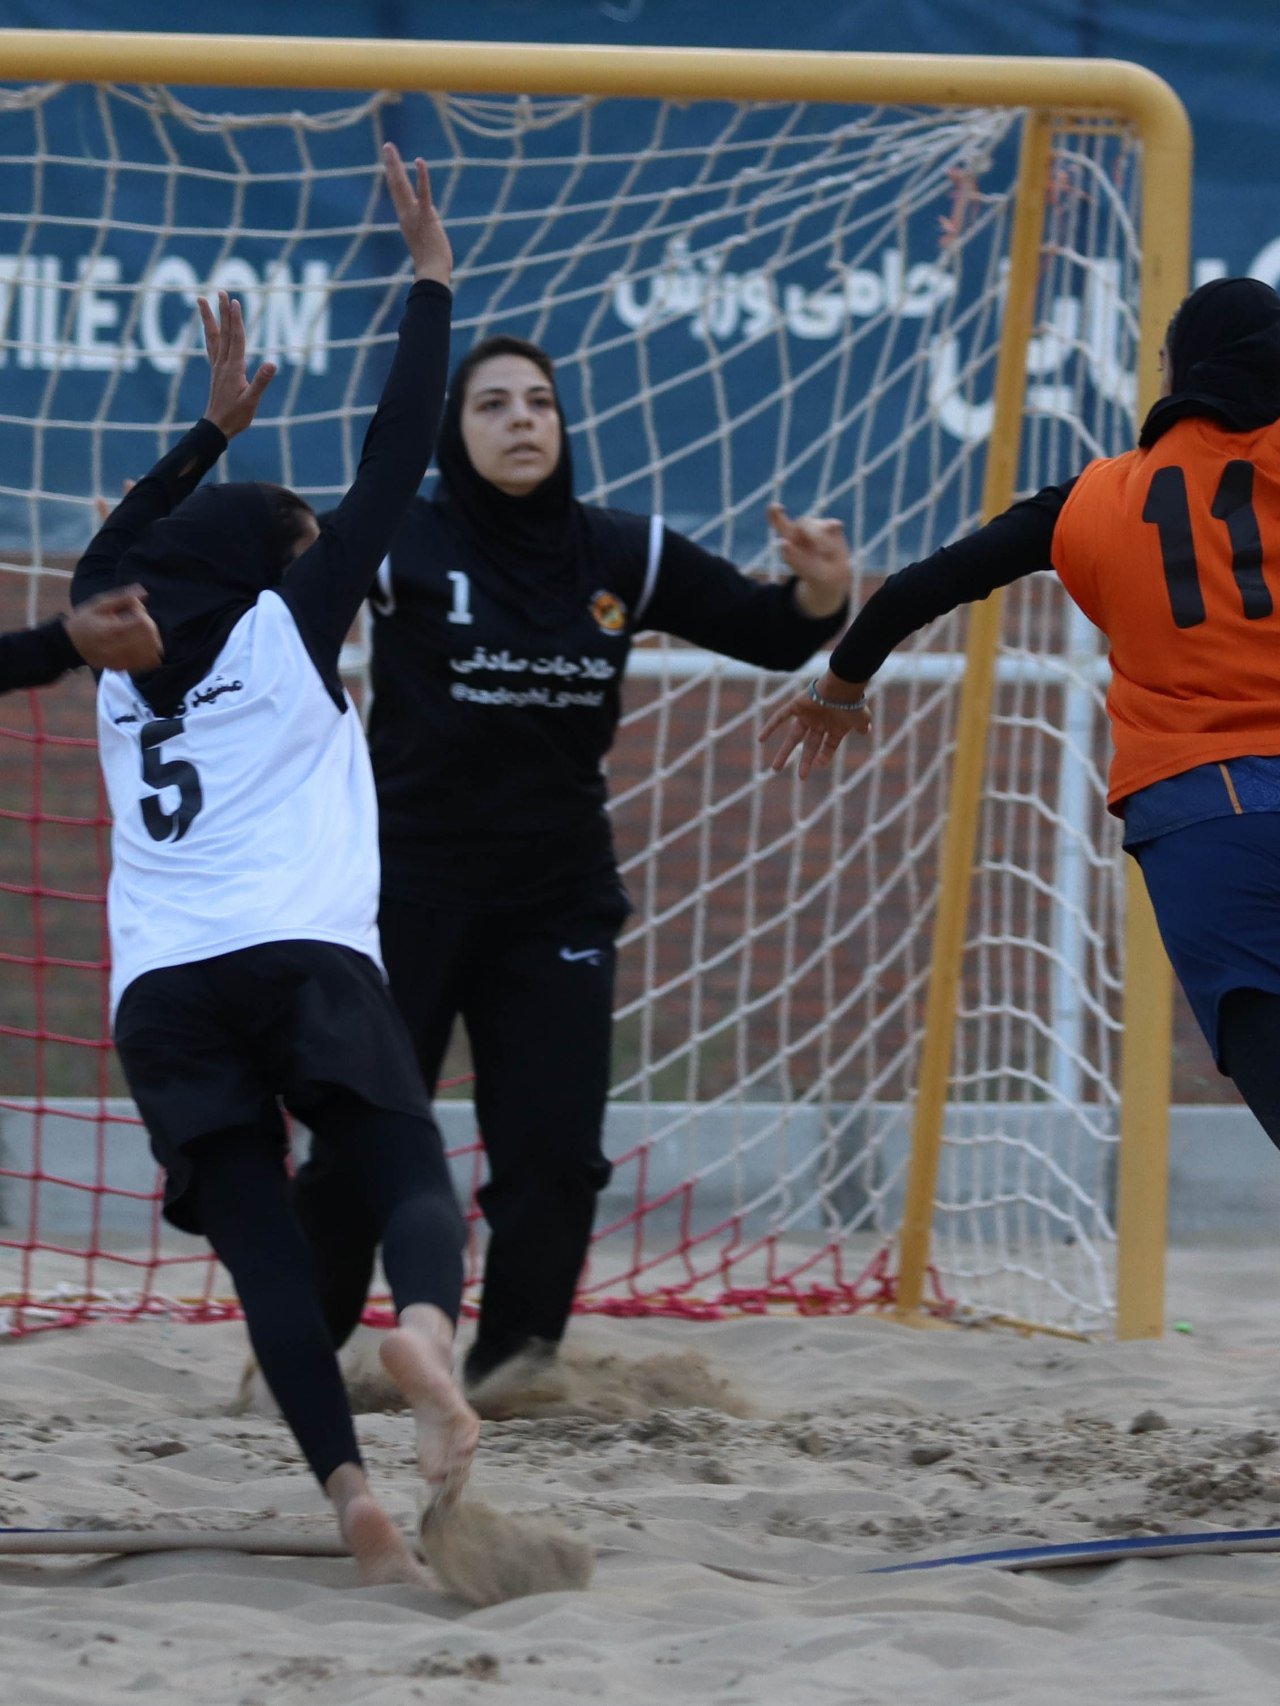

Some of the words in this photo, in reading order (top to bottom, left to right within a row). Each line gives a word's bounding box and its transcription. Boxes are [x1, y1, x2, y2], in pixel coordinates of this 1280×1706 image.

[785, 249, 956, 340] حامی
[446, 570, 473, 625] 1
[1142, 459, 1274, 629] 11
[139, 718, 204, 843] 5
